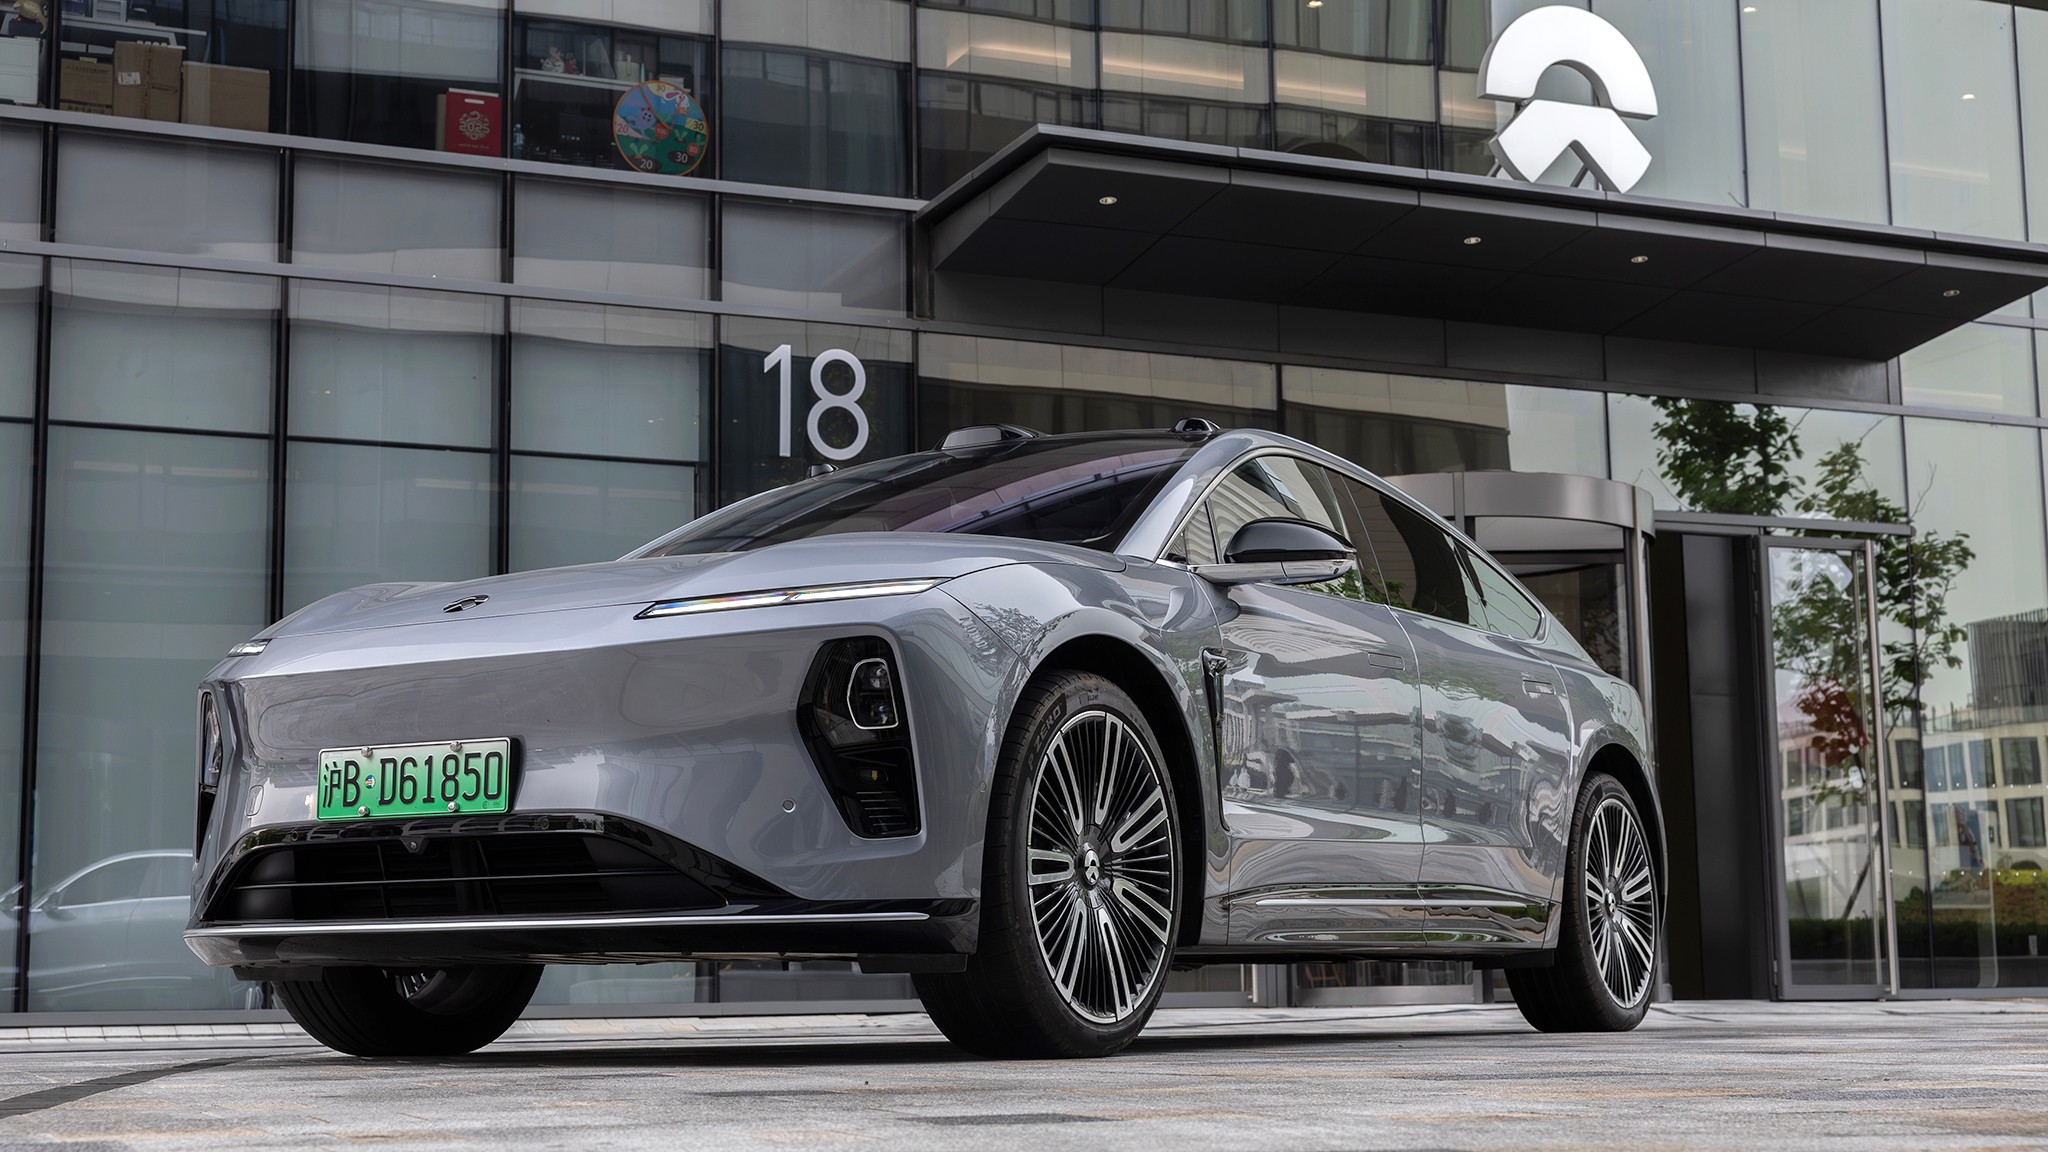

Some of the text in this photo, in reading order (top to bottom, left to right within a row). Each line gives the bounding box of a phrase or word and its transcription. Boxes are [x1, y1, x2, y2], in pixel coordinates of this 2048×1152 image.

[617, 123, 629, 134] 20
[693, 122, 704, 131] 30
[675, 151, 688, 163] 30
[640, 159, 653, 170] 20
[764, 344, 869, 460] 18
[1034, 704, 1062, 753] ZERO
